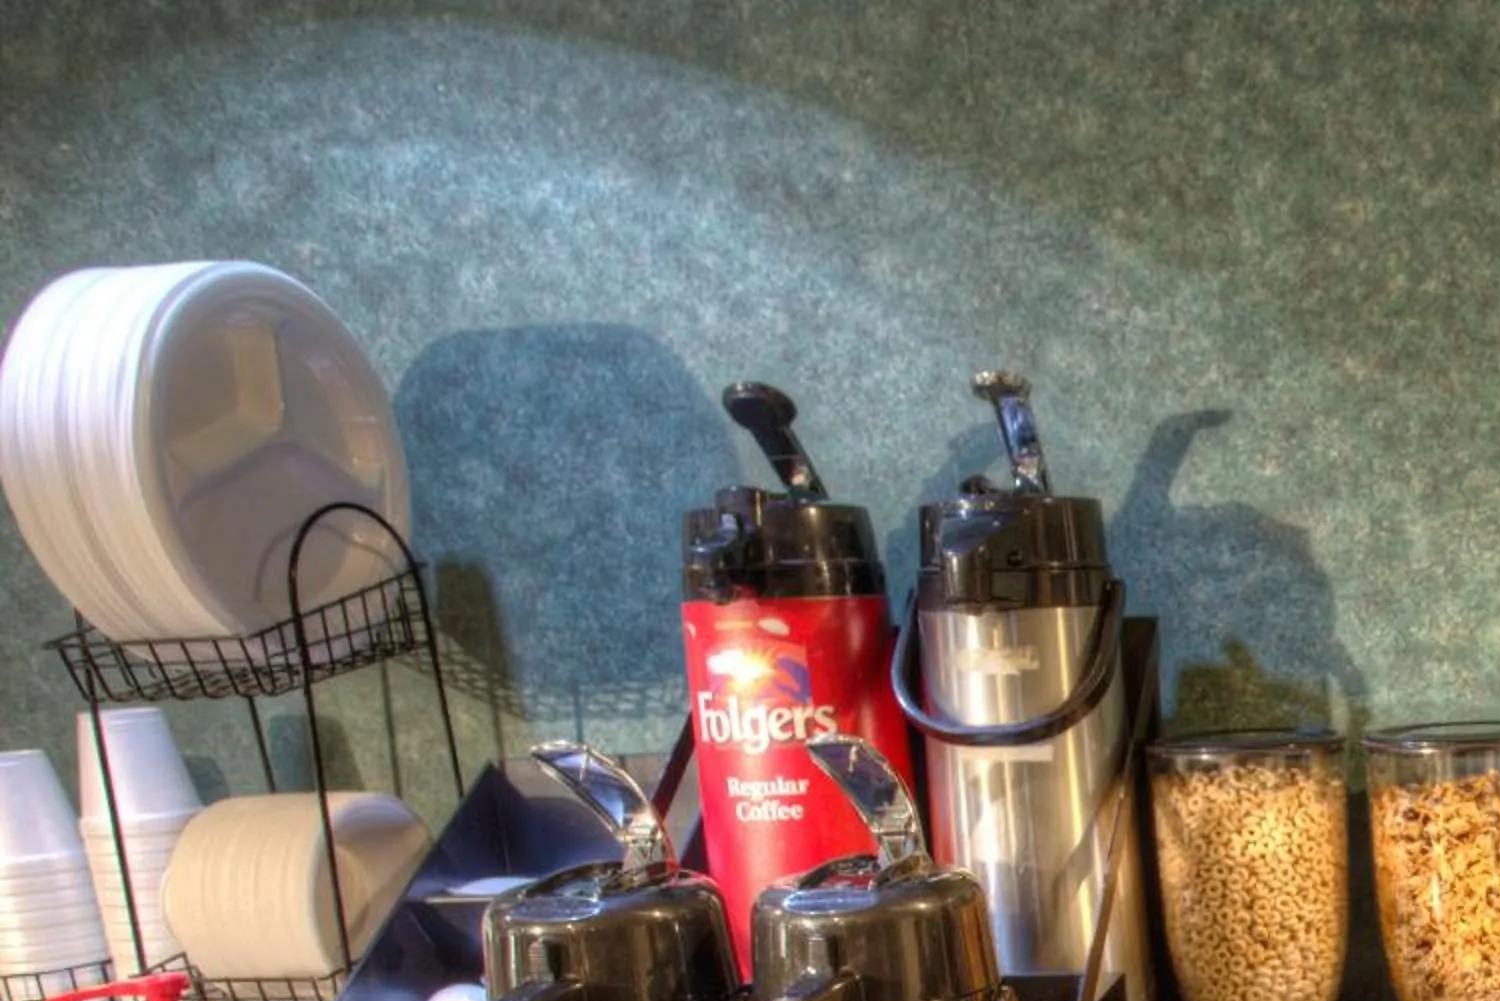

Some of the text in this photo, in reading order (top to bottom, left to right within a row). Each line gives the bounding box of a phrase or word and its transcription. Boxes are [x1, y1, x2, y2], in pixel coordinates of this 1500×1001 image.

[698, 691, 838, 755] Folgers
[727, 776, 809, 800] Regular
[736, 801, 804, 822] Coffee
